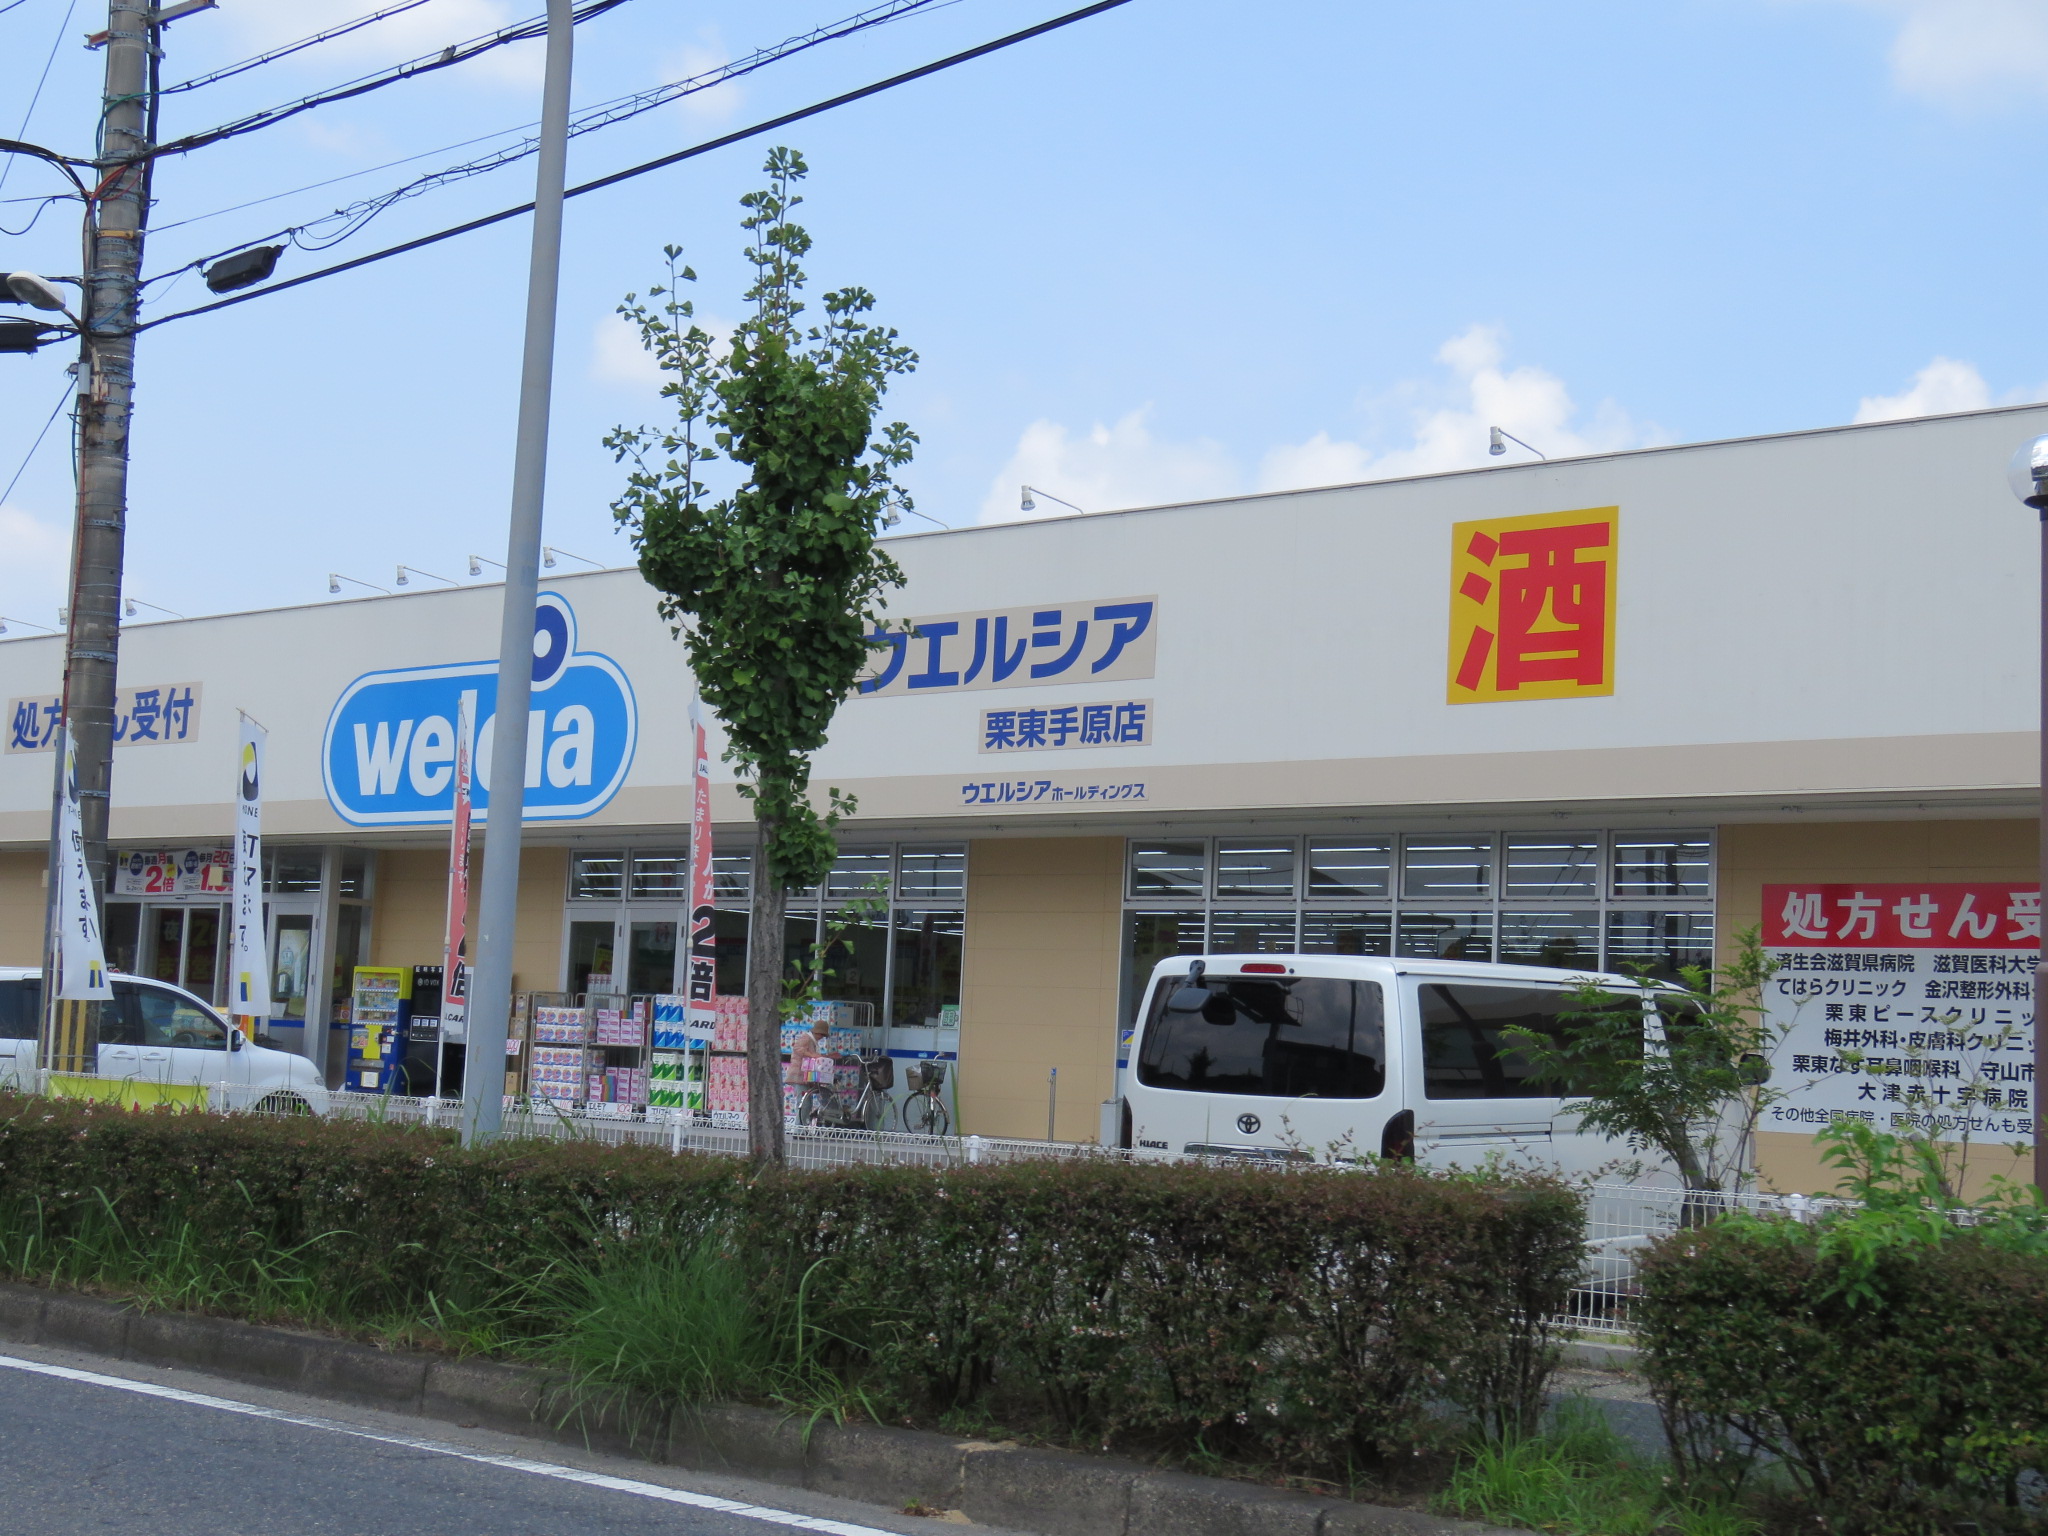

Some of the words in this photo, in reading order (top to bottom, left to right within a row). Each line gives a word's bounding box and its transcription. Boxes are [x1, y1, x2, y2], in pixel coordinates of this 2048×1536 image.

[1455, 522, 1610, 692] 酒
[858, 602, 1154, 694] ウエルシア
[11, 687, 194, 749] 処方ん受付
[985, 702, 1147, 750] 栗東手原店
[961, 780, 1146, 804] ウエルシアホールディングス
[1781, 891, 2041, 941] 処方せん受
[1776, 952, 1916, 973] 済生会滋賀県病院
[1776, 978, 1907, 997] てはらクリニック
[1925, 979, 2035, 1001] 金沢整形外科
[1139, 1139, 1169, 1150] HIACE
